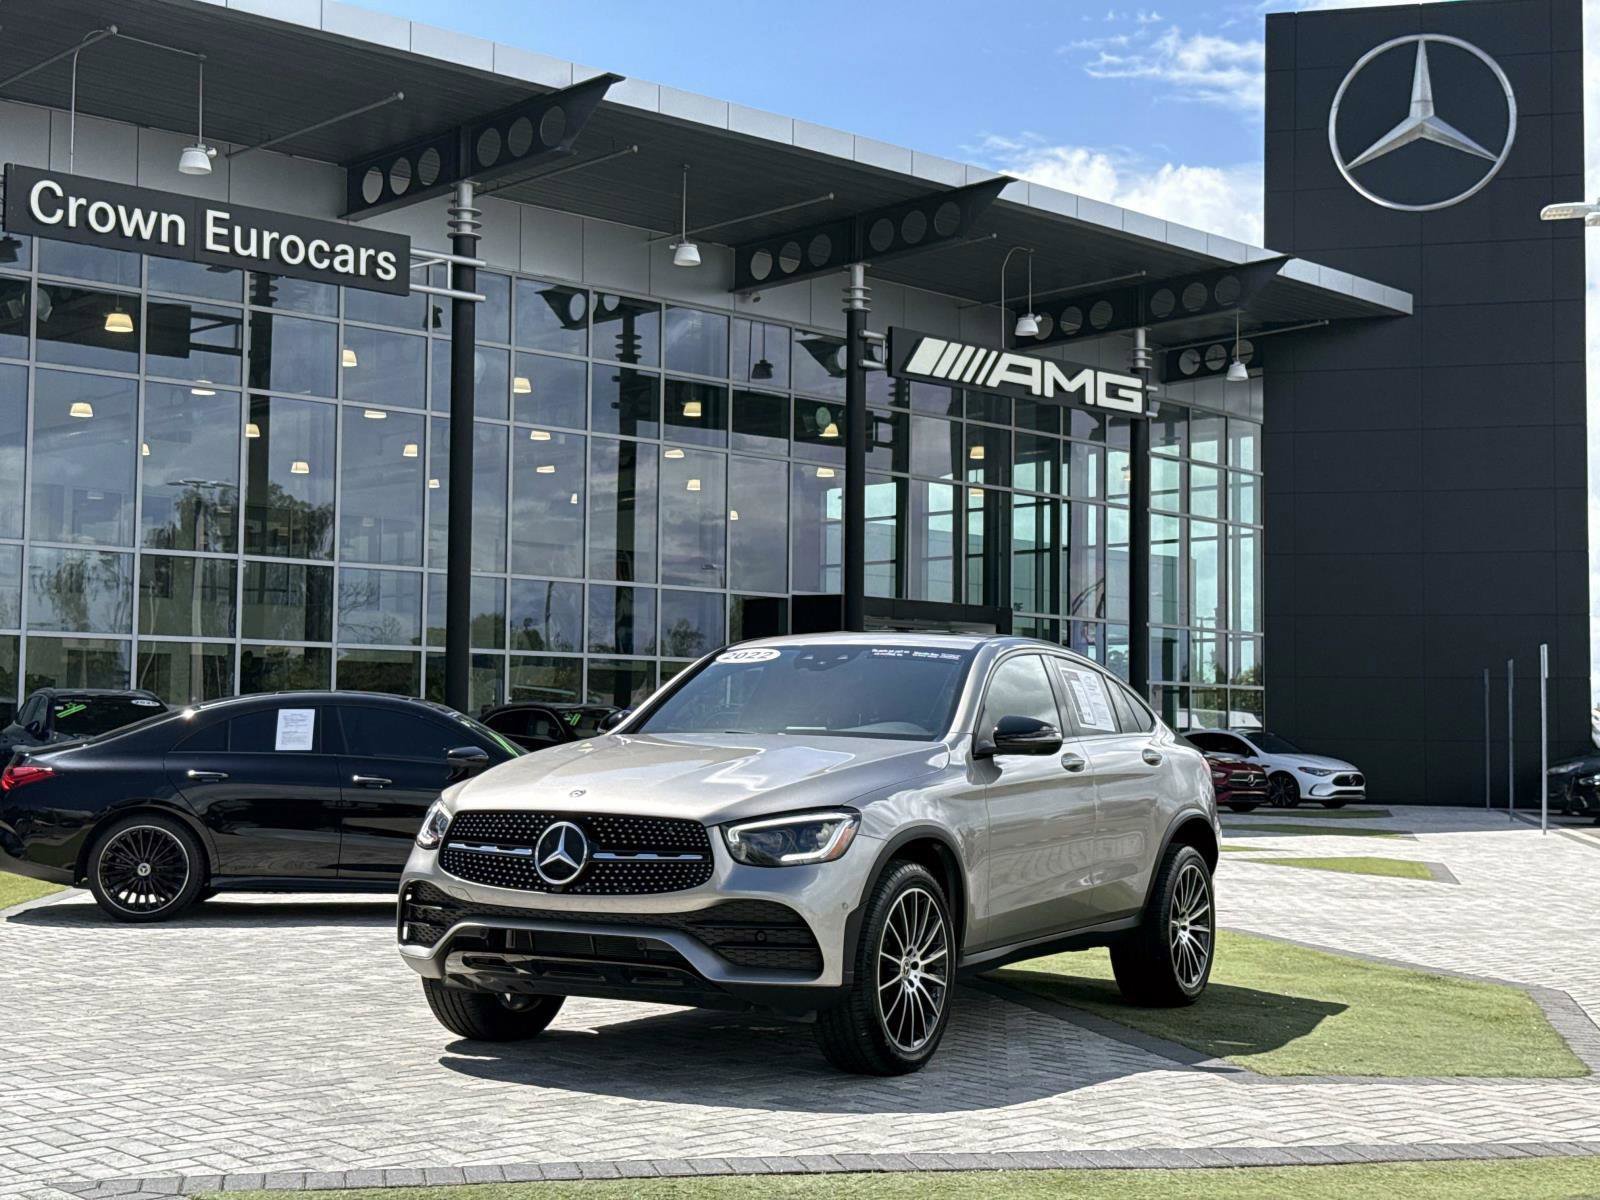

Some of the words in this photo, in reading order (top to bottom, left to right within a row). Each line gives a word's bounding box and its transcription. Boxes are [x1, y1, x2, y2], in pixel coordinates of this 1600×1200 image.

[30, 179, 186, 246] Crown
[205, 209, 397, 281] Eurocars
[986, 351, 1142, 413] AMG
[721, 651, 774, 660] 2022
